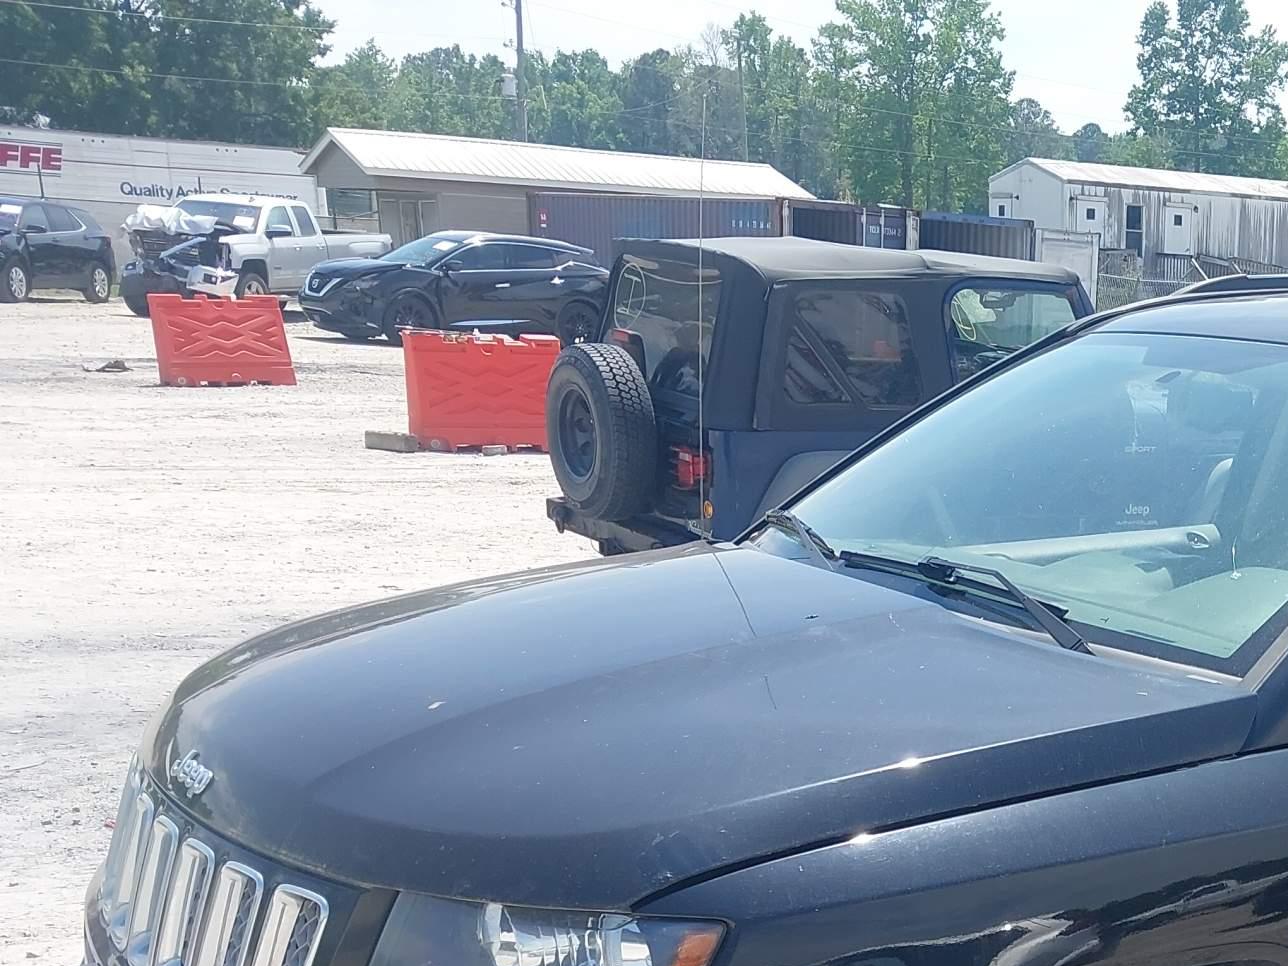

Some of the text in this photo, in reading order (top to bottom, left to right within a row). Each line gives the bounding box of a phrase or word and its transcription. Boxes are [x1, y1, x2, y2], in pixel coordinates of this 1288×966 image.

[120, 181, 173, 201] Quality
[1125, 503, 1150, 517] Jeep
[170, 749, 213, 798] Jeep
